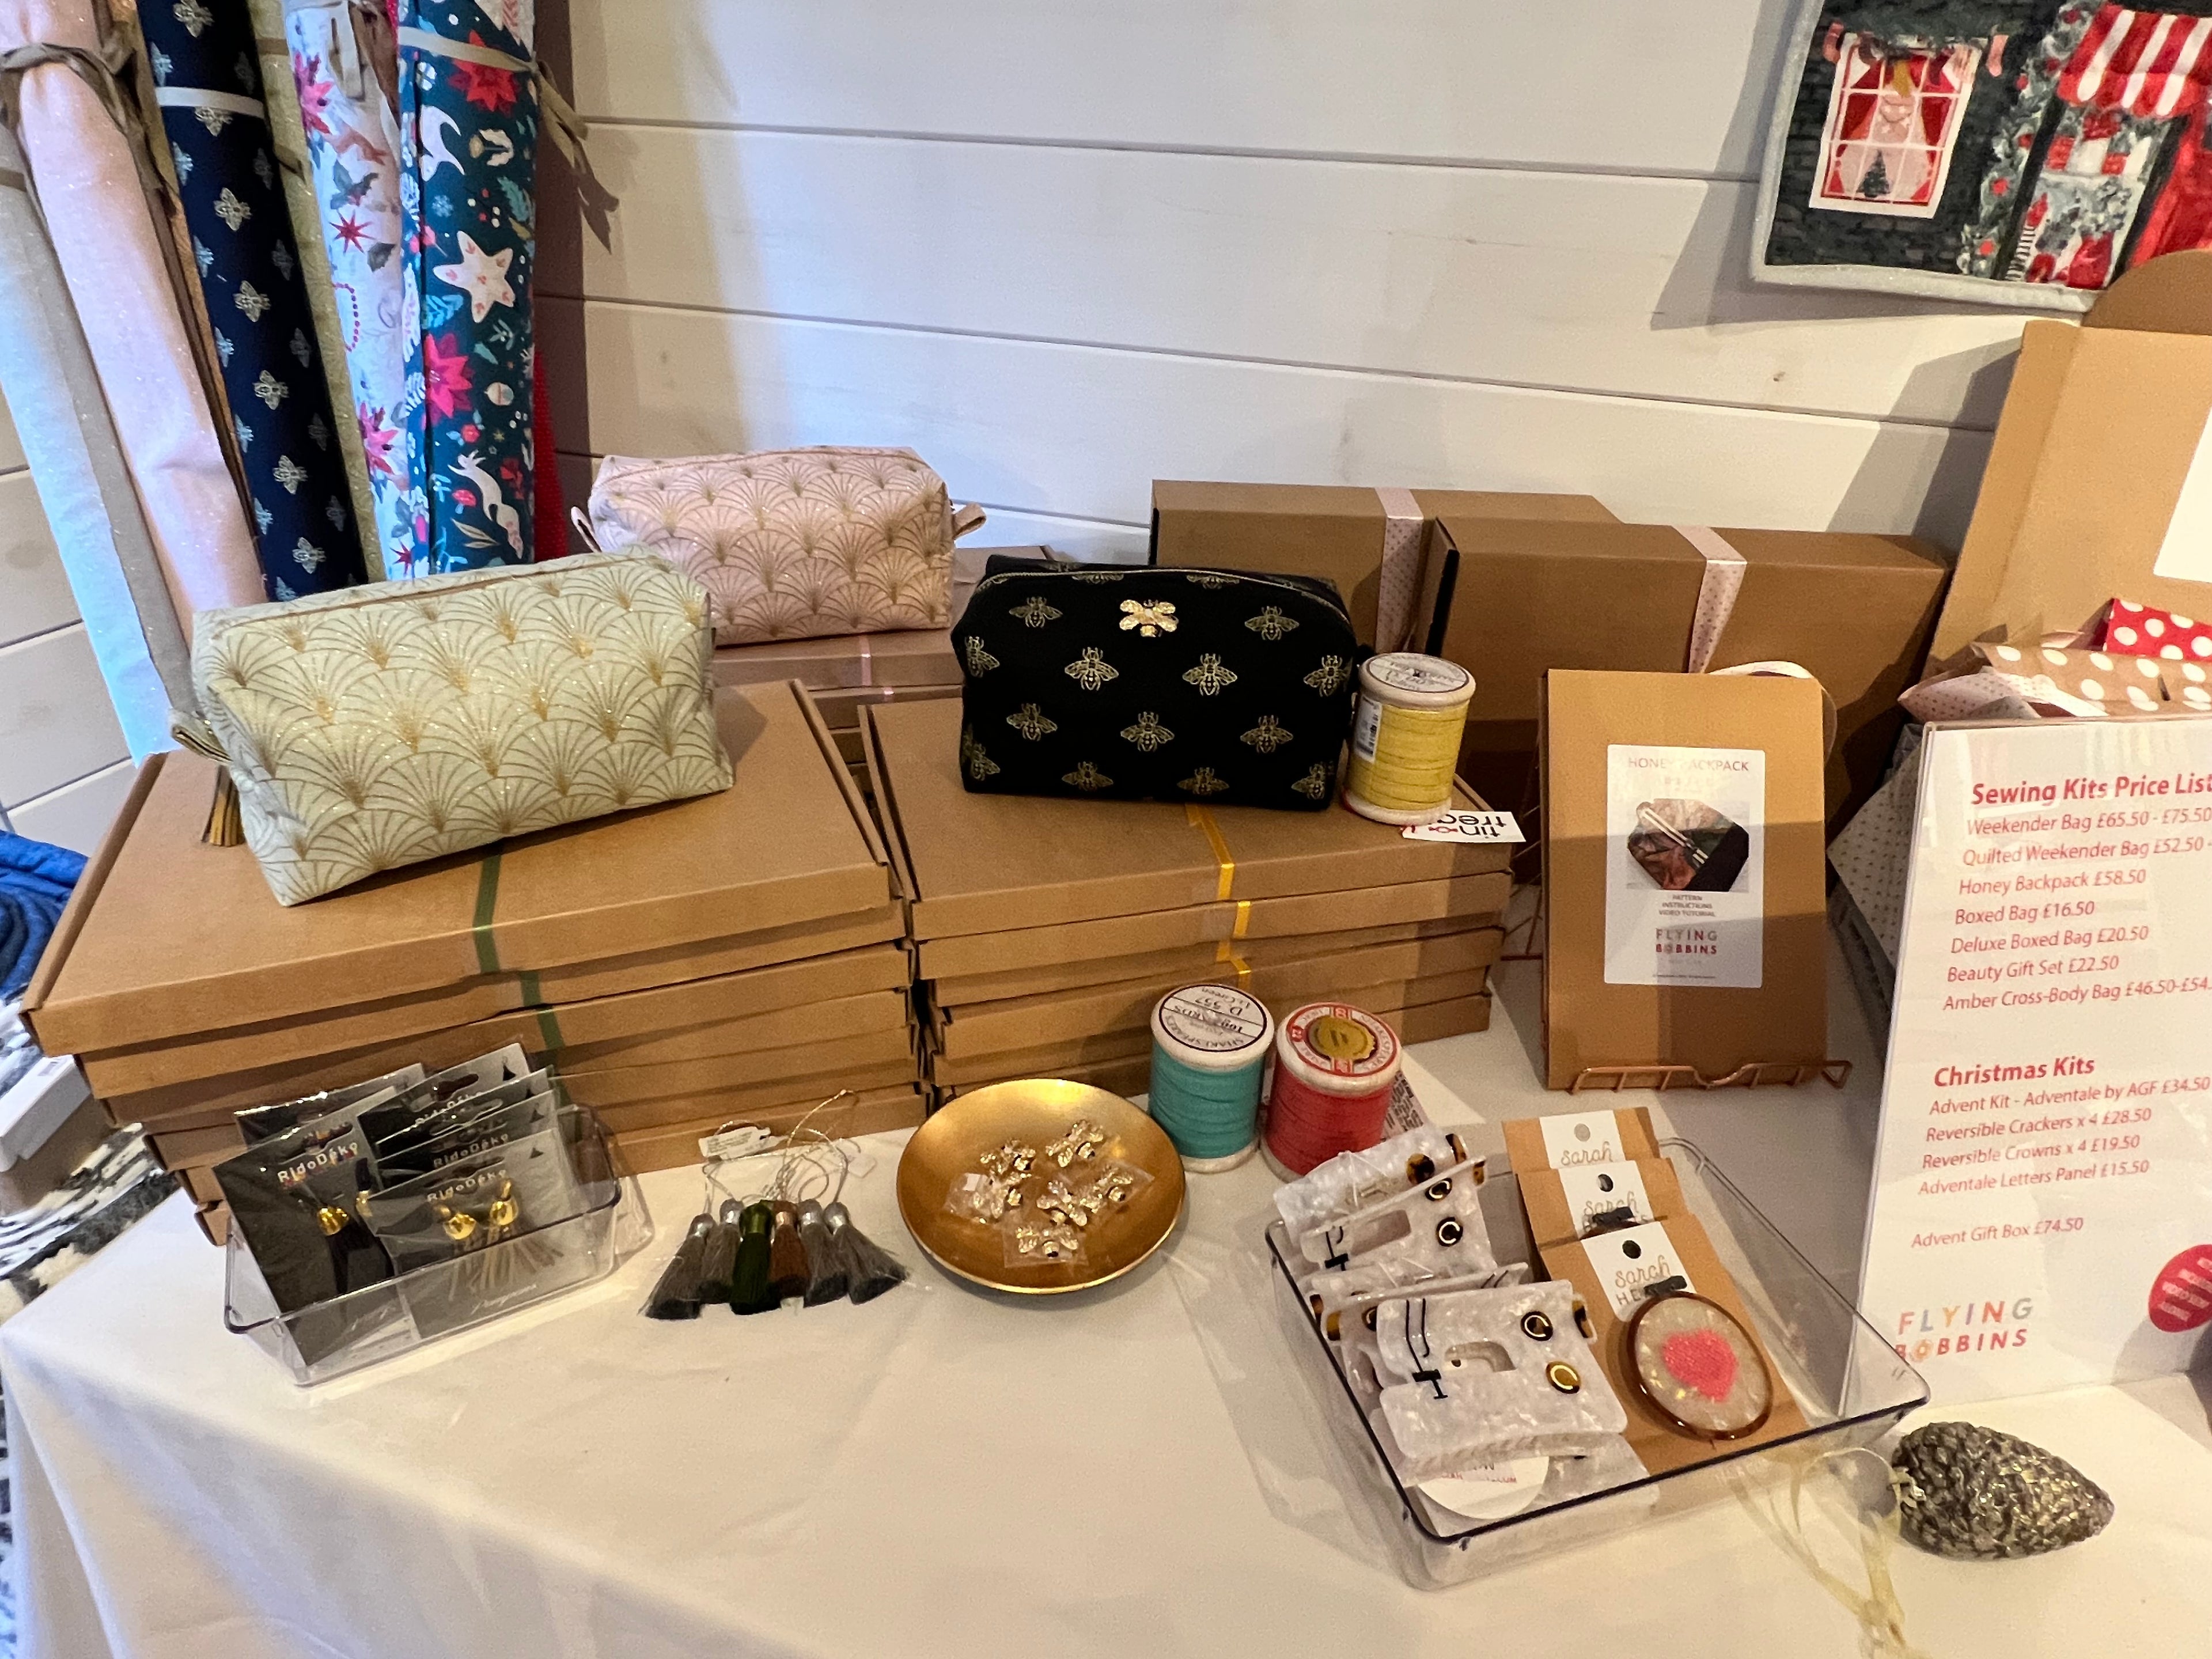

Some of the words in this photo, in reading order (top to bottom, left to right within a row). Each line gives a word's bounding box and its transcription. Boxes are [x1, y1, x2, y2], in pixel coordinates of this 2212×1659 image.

[1680, 759, 1749, 772] ACKPACK
[1971, 781, 2056, 806] Sewing
[2063, 779, 2108, 801] Kits
[2115, 774, 2169, 797] Price
[1967, 817, 2057, 835] Weekender
[2061, 815, 2092, 833] Bag
[2097, 810, 2149, 828] £65.50
[2161, 807, 2212, 824] £75.50
[1963, 849, 2021, 866] Quilted
[2026, 843, 2116, 861] Weekender
[2120, 840, 2149, 859] Bag
[2153, 836, 2204, 854] £52.50
[1959, 879, 2010, 897] Honey
[2016, 873, 2089, 892] Backpack
[2094, 869, 2146, 887] £58.50
[1955, 908, 2004, 925] Boxed
[2009, 906, 2037, 923] Bag
[2043, 901, 2095, 918] £16.50
[1656, 928, 1718, 941] FLYING
[1656, 944, 1717, 955] BOBBINS
[1951, 937, 2007, 954] Deluxe
[2010, 933, 2059, 949] Boxed
[2063, 930, 2092, 948] Bag
[2097, 926, 2149, 944] £20.50
[1948, 965, 2003, 983] Beauty
[2006, 962, 2034, 978] Gift
[2039, 961, 2064, 976] Set
[2068, 956, 2119, 972] £22.50
[1942, 995, 1997, 1011] Amber
[2001, 986, 2088, 1006] Cross-Body
[2092, 984, 2121, 1001] Bag
[1934, 1064, 2047, 1088] Christmas
[2052, 1056, 2095, 1077] Kits
[1929, 1097, 1987, 1115] Advent
[1989, 1096, 2010, 1109] Kit
[2023, 1087, 2101, 1107] Adventale
[2104, 1085, 2124, 1100] by
[2126, 1081, 2158, 1098] AGF
[2161, 1077, 2210, 1095] £34.50
[1926, 1122, 2005, 1142] Reversible
[2009, 1115, 2073, 1135] Crackers
[2077, 1118, 2086, 1127] x
[2089, 1115, 2099, 1126] 4
[2101, 1108, 2152, 1126] £28.50
[1922, 1149, 2001, 1169] Reversible
[2005, 1143, 2061, 1160] Crowns
[2066, 1145, 2074, 1154] x
[2078, 1141, 2086, 1151] 4
[2090, 1135, 2141, 1153] £19.50
[1918, 1175, 1997, 1195] Adventale
[2000, 1169, 2051, 1188] Letters
[2055, 1165, 2096, 1182] Panel
[2100, 1160, 2149, 1179] £15.50
[1912, 1230, 1967, 1248] Advent
[1971, 1227, 1997, 1242] Gift
[2001, 1224, 2030, 1238] Box
[2034, 1217, 2084, 1235] £74.50
[1899, 1298, 2033, 1335] FLYING
[1895, 1329, 2027, 1363] BOBBINS
